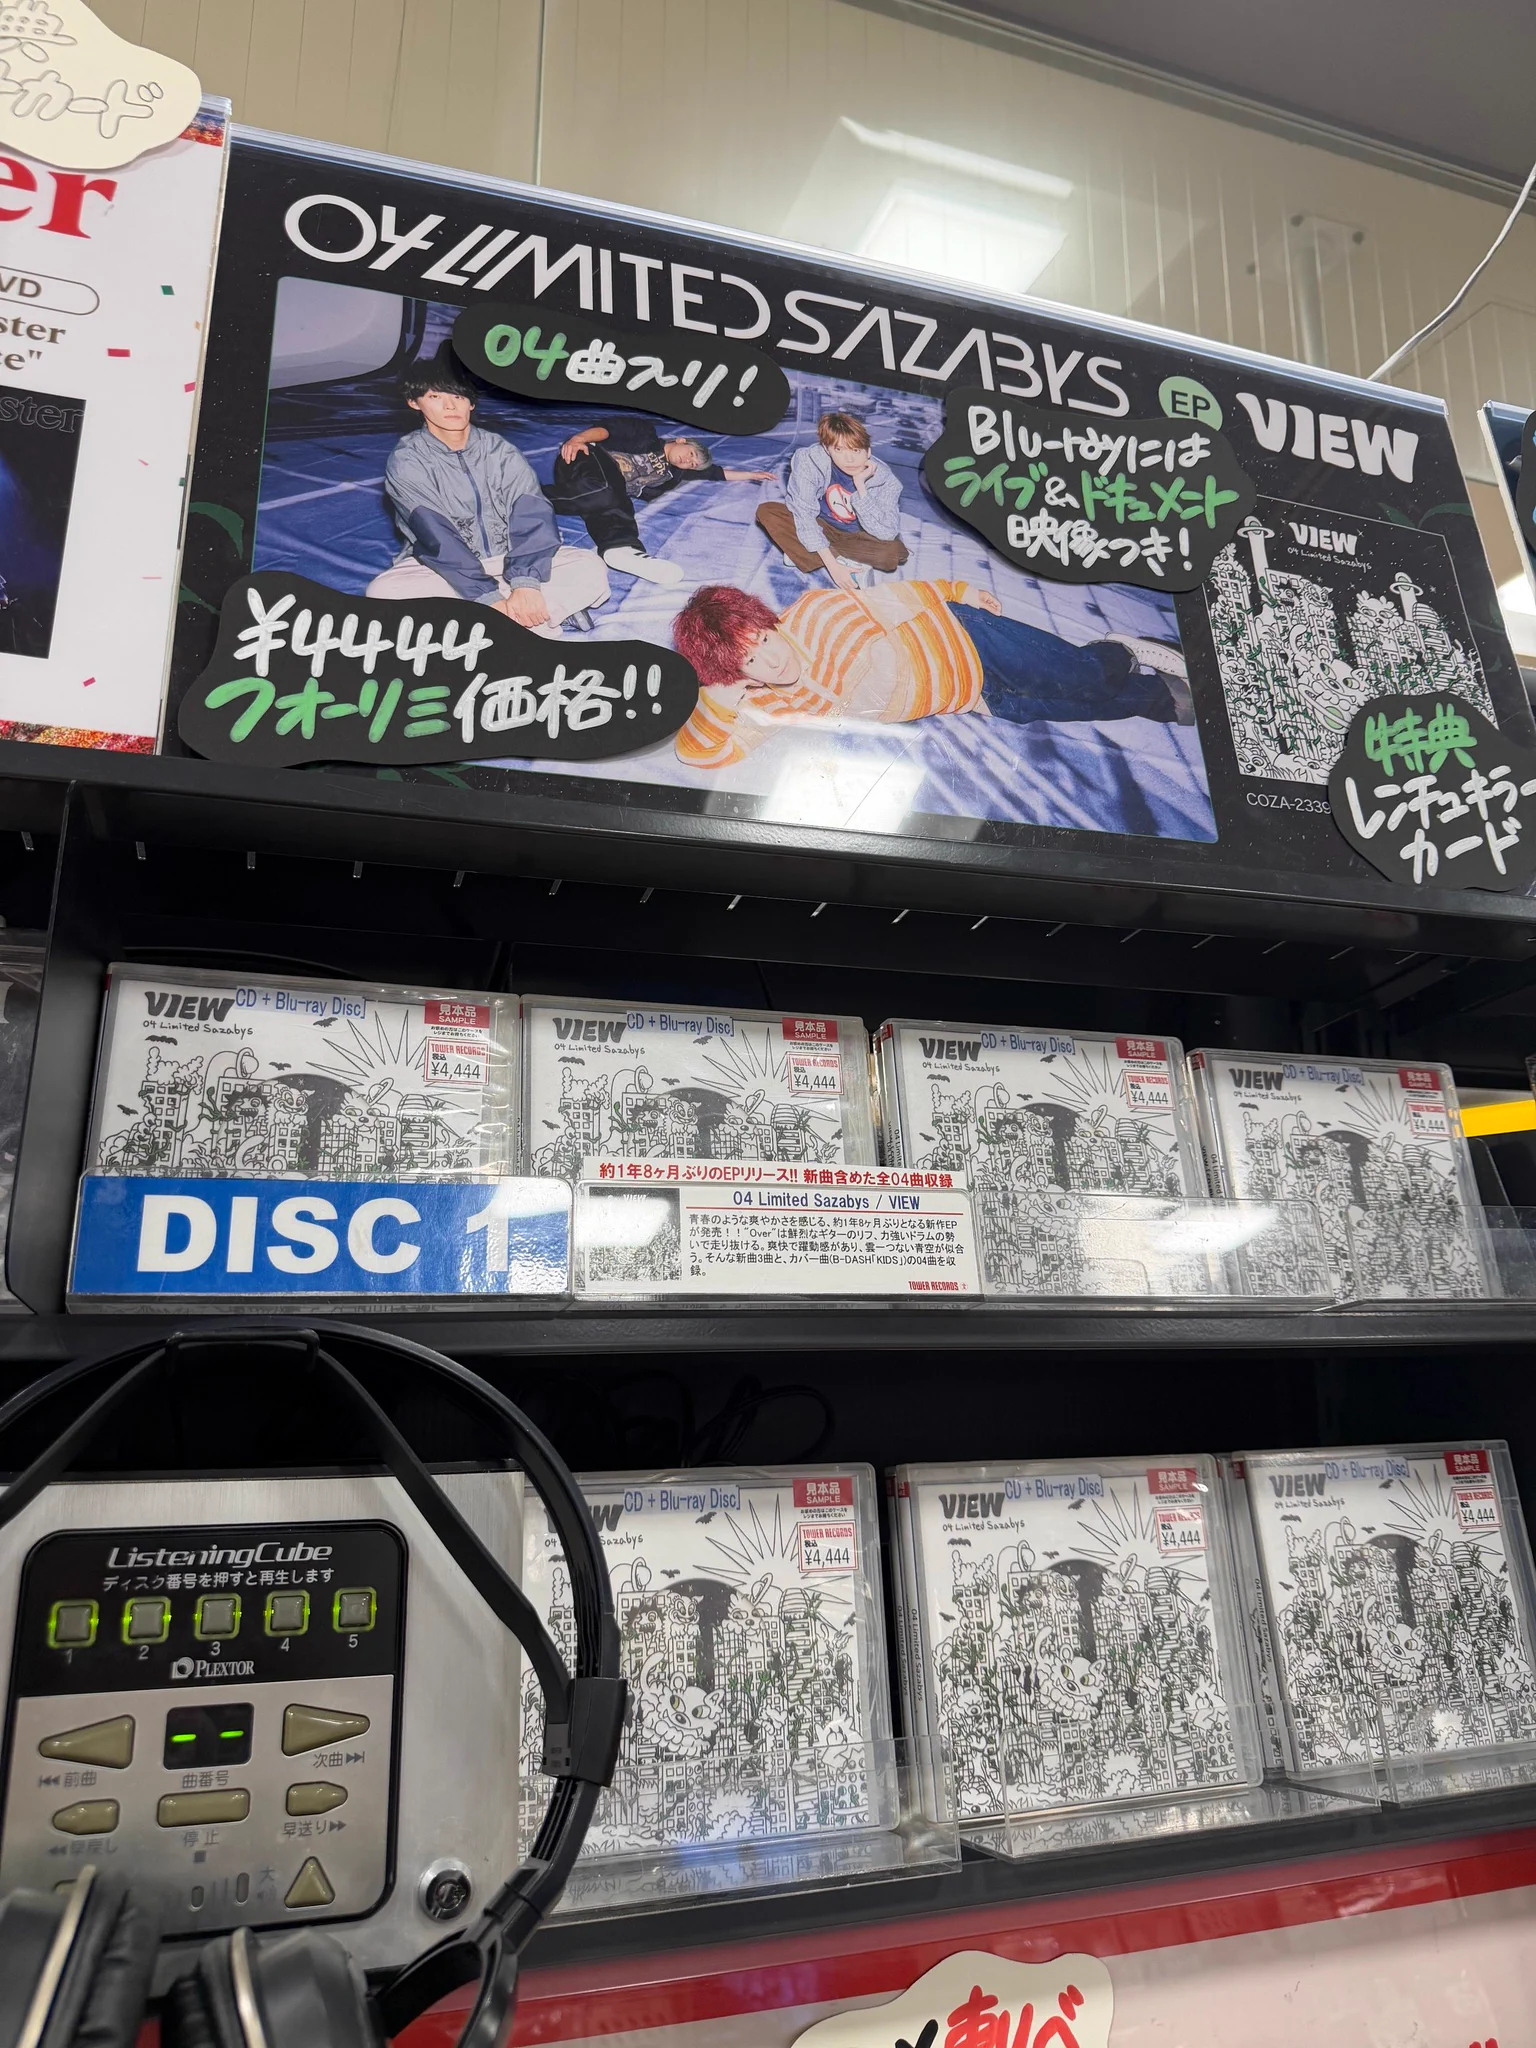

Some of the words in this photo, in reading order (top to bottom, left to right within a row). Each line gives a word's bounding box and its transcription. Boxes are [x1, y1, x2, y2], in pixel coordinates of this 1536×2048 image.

[0, 59, 164, 139] カード
[421, 225, 772, 340] LIMITED
[776, 290, 1130, 417] SAZABYS
[0, 349, 43, 371] e"
[1171, 391, 1211, 418] EP
[968, 405, 1211, 476] Blu-rayには
[1236, 392, 1419, 483] VIEW
[1288, 522, 1358, 556] VIEW
[1287, 547, 1299, 556] 04
[1300, 549, 1332, 561] Limited
[1332, 555, 1373, 573] Sazabys
[233, 588, 494, 678] ¥4444
[1364, 702, 1478, 777] 特典
[1246, 792, 1332, 815] COZA-2339
[1400, 816, 1523, 885] カード
[145, 991, 236, 1022] VIEW
[236, 988, 257, 1007] CD
[275, 991, 327, 1017] Blu-ray
[439, 1003, 476, 1018] 見本品
[142, 1020, 157, 1028] 04
[160, 1021, 200, 1032] Limited
[203, 1023, 253, 1040] Sazabys
[438, 1016, 476, 1025] SAMPLE
[552, 1017, 627, 1043] VIEW
[627, 1013, 645, 1030] CD
[659, 1014, 702, 1035] Blu-ray
[794, 1020, 826, 1033] 見本品
[794, 1032, 827, 1040] SAMPLE
[981, 1032, 997, 1048] CD
[1010, 1034, 1047, 1054] Blu-ray
[1126, 1040, 1155, 1052] 見本品
[431, 1044, 454, 1053] TOWER
[554, 1043, 566, 1051] 04
[569, 1044, 601, 1053] Limited
[604, 1045, 646, 1059] Sazabys
[918, 1038, 982, 1062] VIEW
[431, 1061, 480, 1080] ¥4,444
[934, 1062, 963, 1071] Limited
[964, 1063, 1001, 1076] Sazabys
[1283, 1064, 1297, 1079] CD
[1307, 1066, 1340, 1084] Blu-ray
[793, 1074, 837, 1090] ¥4,444
[1228, 1068, 1284, 1091] VIEW
[1130, 1090, 1169, 1106] ¥4,444
[803, 1168, 954, 1188] 新曲含めた全04曲収録
[733, 1190, 753, 1206] 04
[758, 1191, 809, 1207] Limited
[814, 1193, 870, 1210] Sazabys
[875, 1194, 883, 1209] /
[888, 1195, 920, 1210] VIEW
[136, 1194, 422, 1275] DISC
[465, 1194, 509, 1272] 1
[690, 1264, 707, 1276] 録。
[908, 1281, 930, 1291] TOWER
[931, 1281, 959, 1291] RECORDS
[1158, 1470, 1187, 1484] 見本品
[1325, 1462, 1340, 1480] CD
[1350, 1460, 1385, 1480] Blu-ray
[806, 1482, 840, 1496] 見本品
[1005, 1480, 1022, 1499] CD
[1035, 1479, 1076, 1499] Blu-ray
[1159, 1483, 1188, 1491] SAMPLE
[1268, 1473, 1326, 1498] VIEW
[624, 1490, 643, 1512] CD
[660, 1489, 706, 1513] Blu-ray
[806, 1495, 841, 1504] SAMPLE
[938, 1492, 1006, 1519] VIEW
[942, 1523, 953, 1532] 04
[955, 1521, 985, 1532] Limited
[987, 1517, 1026, 1533] Sazabys
[1460, 1508, 1496, 1525] ¥4,444
[544, 1538, 557, 1548] 04
[802, 1529, 824, 1539] TOWER
[825, 1527, 853, 1538] RECORDS
[1162, 1530, 1201, 1548] ¥4,444
[108, 1541, 334, 1569] ListeningCube
[804, 1547, 850, 1568] ¥4,444
[102, 1567, 335, 1592] ディスク番号を押すと再生します
[65, 1648, 73, 1664] 1
[139, 1645, 149, 1660] 2
[210, 1641, 221, 1656] 3
[280, 1637, 291, 1652] 4
[348, 1633, 359, 1648] 5
[313, 1752, 343, 1768] 次曲
[63, 1770, 97, 1788] 前曲
[182, 1769, 230, 1789] 曲番号
[283, 1819, 328, 1837] 早送り
